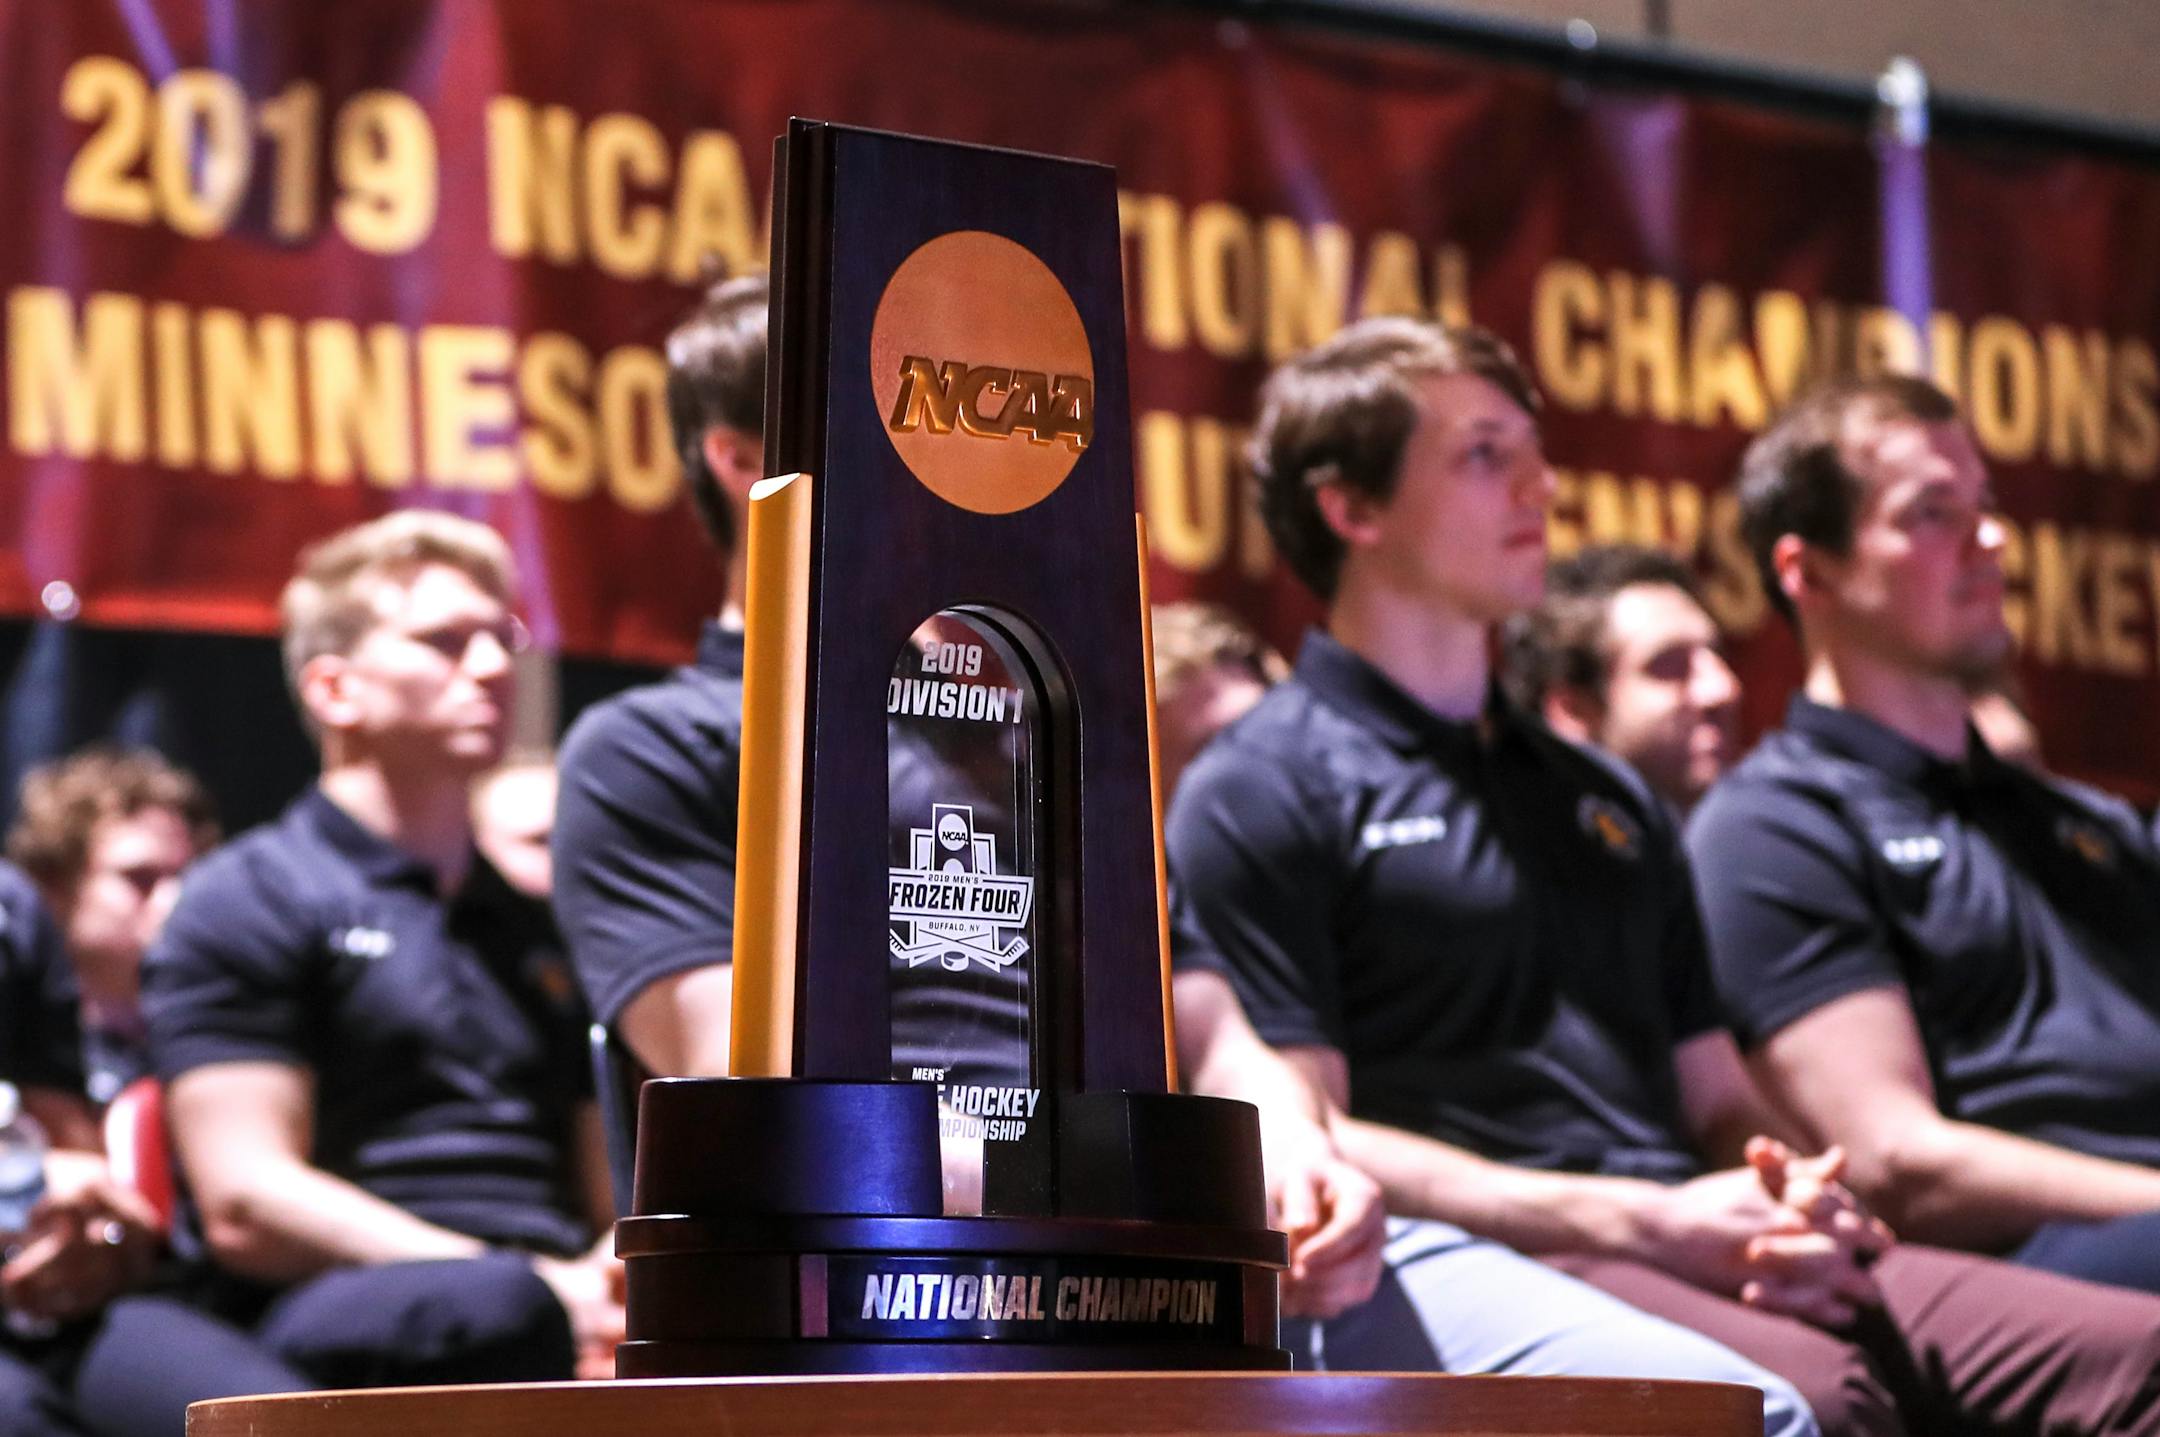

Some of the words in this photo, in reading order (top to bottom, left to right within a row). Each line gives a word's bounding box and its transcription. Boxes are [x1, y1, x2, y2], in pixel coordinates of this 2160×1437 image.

[60, 56, 440, 255] 2019
[484, 93, 770, 285] NCA
[6, 285, 690, 513] MINNESO
[889, 355, 1094, 454] NCAA
[921, 641, 983, 677] 2019
[887, 677, 1007, 723] DIVISION
[1012, 688, 1024, 724] I
[942, 831, 965, 841] NCAA
[928, 874, 950, 882] 2019
[953, 875, 979, 884] MEN'S
[890, 882, 966, 911] FROZEN
[970, 887, 1021, 914] FOUR
[969, 923, 980, 932] NY
[912, 1067, 945, 1081] MEN'S
[951, 1084, 1040, 1118] HOCKEY
[939, 1118, 1027, 1142] MPIONSHIP
[861, 1274, 1046, 1321] NATIONAL
[1055, 1276, 1217, 1325] CHAMPION
